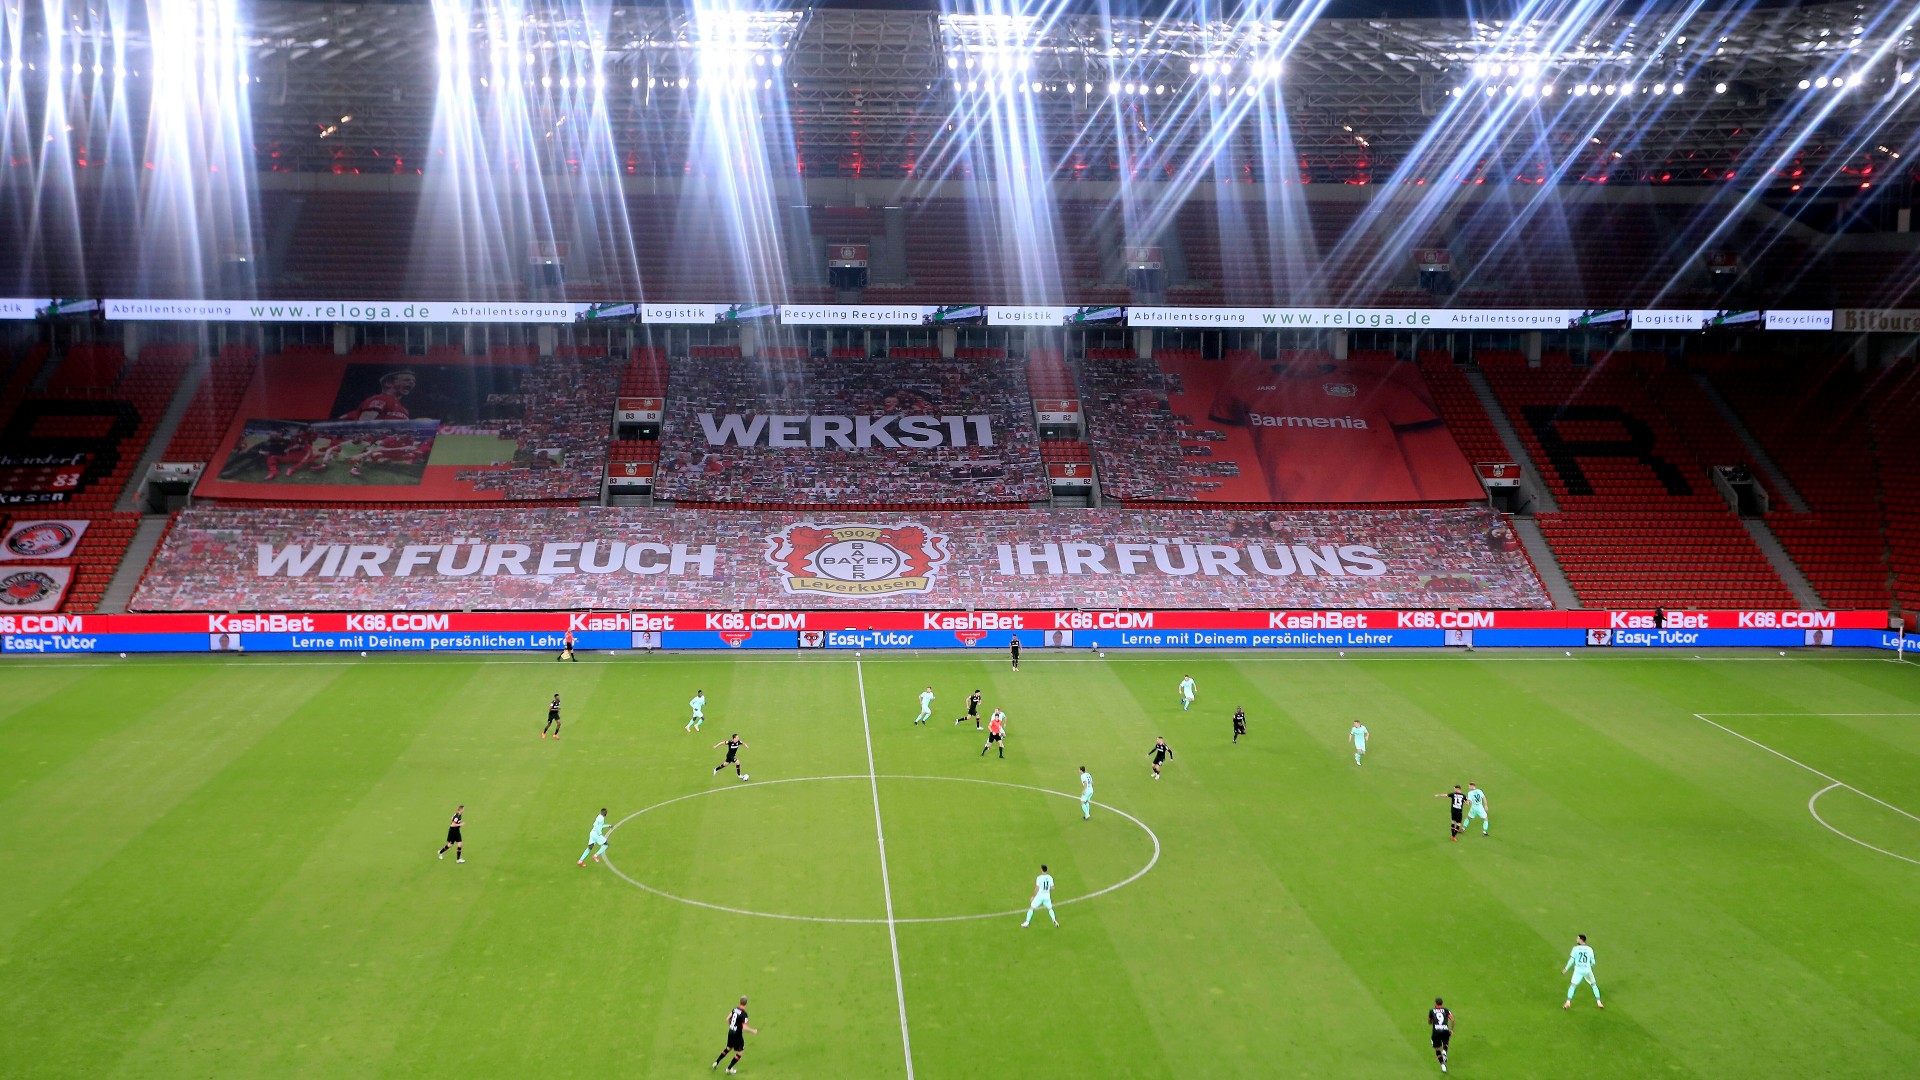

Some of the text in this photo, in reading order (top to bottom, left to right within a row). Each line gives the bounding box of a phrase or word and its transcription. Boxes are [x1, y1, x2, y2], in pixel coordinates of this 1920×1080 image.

[112, 304, 232, 316] Abfallentsorgung
[250, 303, 430, 320] www.reloga.de
[451, 306, 568, 318] Abfallentsorgung
[646, 308, 706, 319] Logistik
[784, 308, 918, 321] Recycling Recycling
[997, 310, 1052, 321] Logistik
[1134, 311, 1246, 322] Abfallentsorgung
[1262, 311, 1432, 327] www.reloga.de
[1451, 314, 1562, 325] Abfallentsorgung
[1637, 314, 1694, 325] Logistik
[1769, 315, 1831, 326] Recycling
[625, 412, 656, 420] B3 B3
[1249, 413, 1369, 430] Barmenia
[697, 412, 994, 448] WERKS11
[52, 473, 80, 487] 83
[837, 531, 876, 539] 1904
[257, 537, 1387, 577] WIR FÜR EUCH IHR FÜR UNS
[823, 557, 894, 565] BAYER
[800, 579, 917, 593] Leverkusen
[208, 614, 449, 632] KashBet K66.COM
[569, 613, 806, 631] KashBet K66.COM
[923, 612, 1153, 630] KashBet K66.COM
[1269, 611, 1495, 629] KashBet K66.COM
[1738, 611, 1836, 629] K66.COM
[4, 635, 97, 652] Easy-Tutor
[292, 635, 334, 647] Lerne
[345, 635, 363, 647] mit
[369, 635, 424, 647] Deinem
[430, 635, 520, 649] persönlichen
[828, 632, 914, 648] Easy-Tutor
[1121, 632, 1393, 647] Lerne mit Deinem persönlichen Lehrer
[1616, 630, 1698, 646] Easy-Tutor
[1578, 951, 1588, 963] 25
[1436, 1012, 1444, 1025] 9
